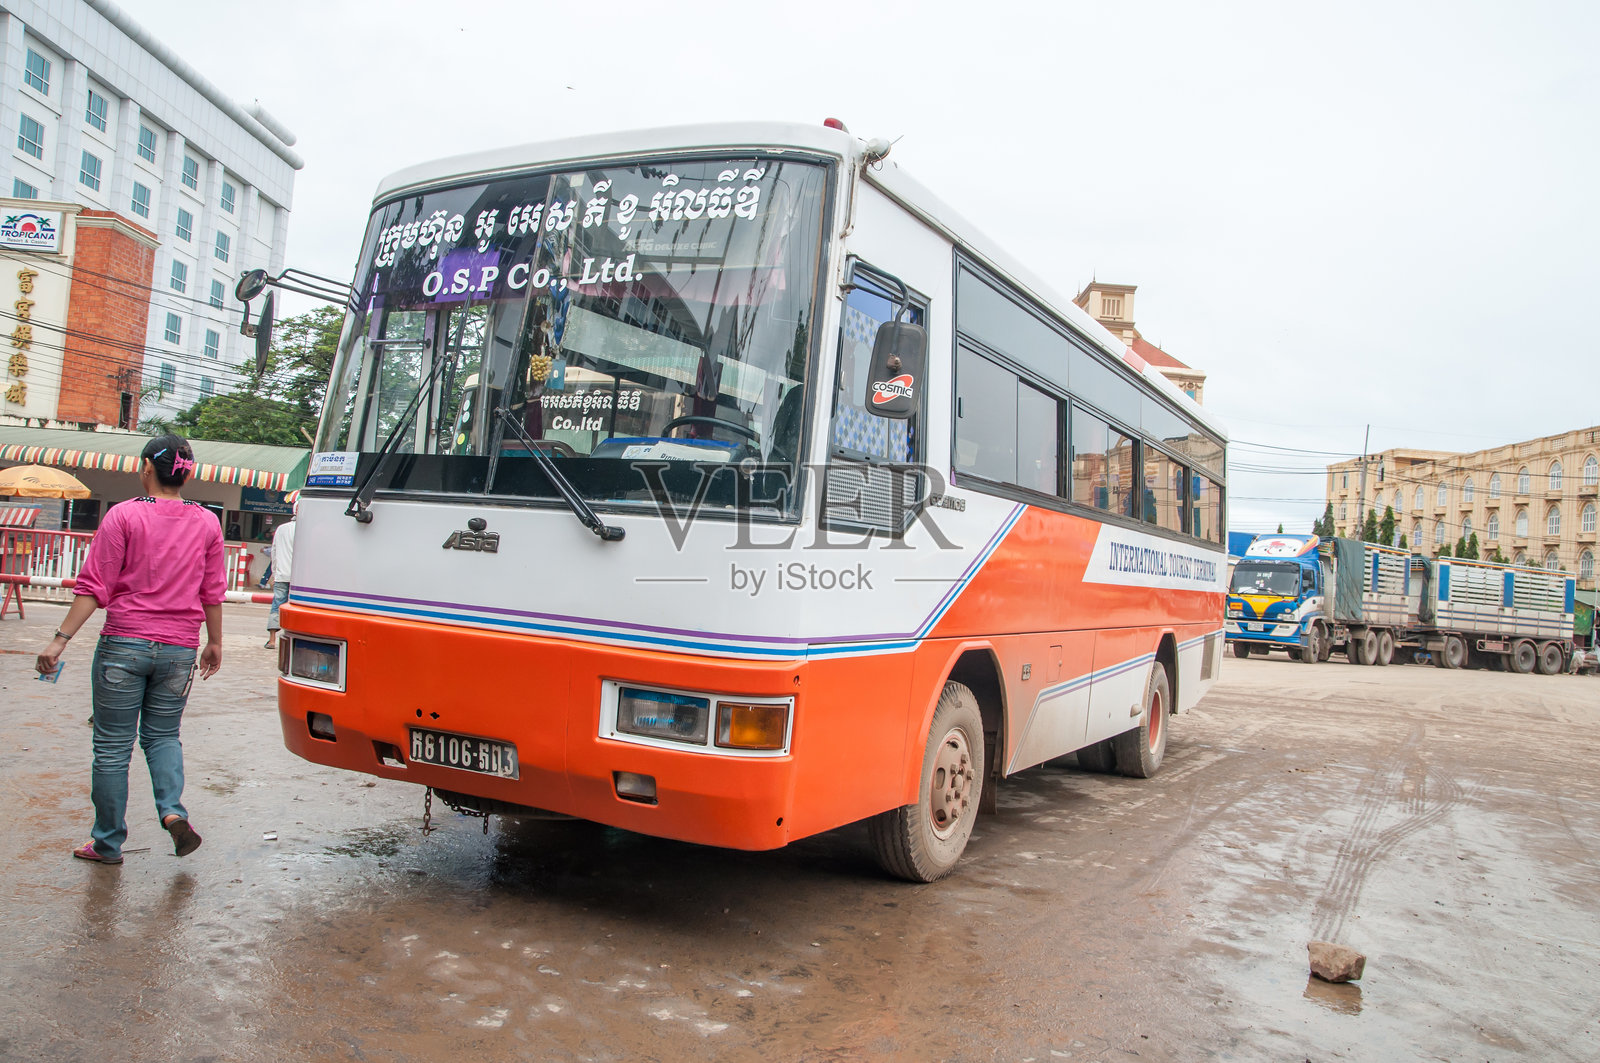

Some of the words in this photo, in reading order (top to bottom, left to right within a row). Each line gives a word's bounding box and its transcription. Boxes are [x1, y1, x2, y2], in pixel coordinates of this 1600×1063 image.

[1, 230, 55, 240] TROPICANA
[423, 266, 499, 297] O.S.P
[507, 263, 568, 292] Co.,
[579, 254, 643, 285] Ltd.
[1109, 542, 1167, 576] INTERNATIONAL
